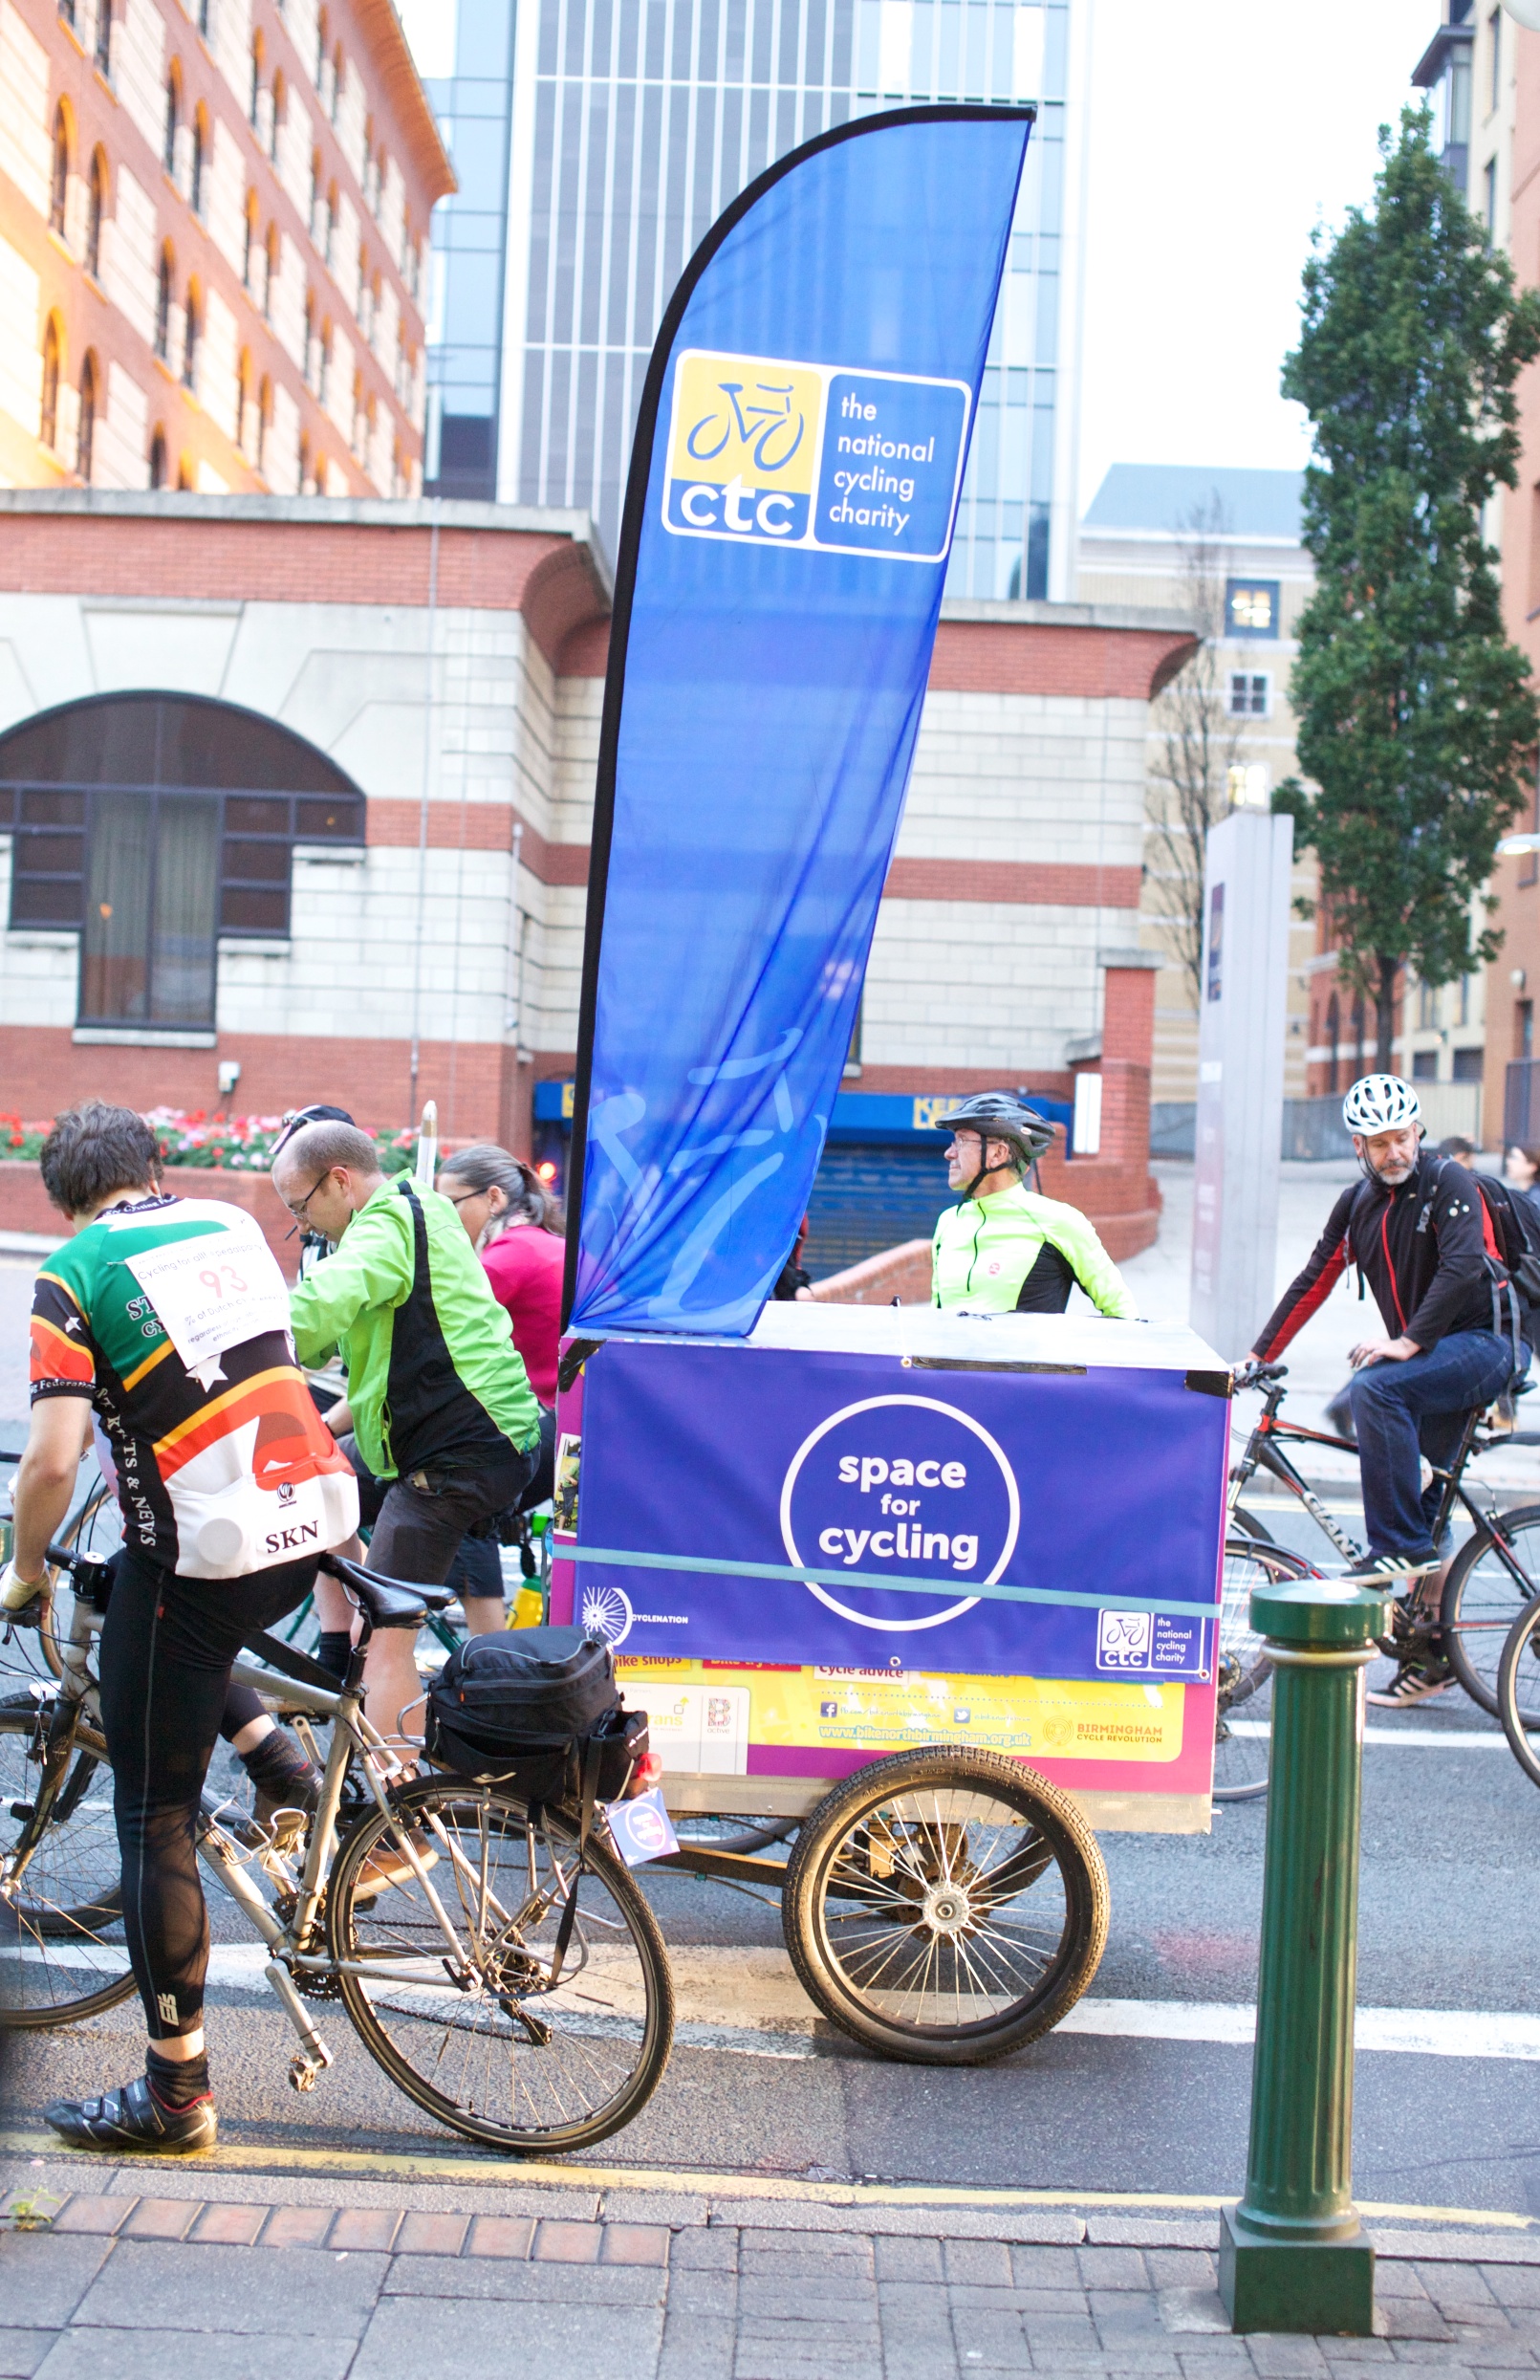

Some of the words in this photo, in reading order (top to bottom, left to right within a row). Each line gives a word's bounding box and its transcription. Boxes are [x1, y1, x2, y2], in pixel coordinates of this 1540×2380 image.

[841, 392, 877, 421] the
[837, 433, 935, 463] national
[834, 466, 915, 502] cycling
[681, 473, 795, 535] ctc
[829, 497, 910, 536] charity
[138, 1260, 178, 1280] Cycling
[178, 1257, 192, 1269] for
[209, 1243, 263, 1258] pedalpay
[199, 1265, 249, 1299] 93
[197, 1309, 207, 1320] of
[209, 1299, 234, 1316] Dutch
[187, 1323, 223, 1344] regardless
[95, 1387, 116, 1408] ST
[107, 1413, 138, 1469] KTS
[126, 1475, 141, 1490] &
[837, 1455, 967, 1493] space
[880, 1493, 921, 1517] for
[265, 1519, 318, 1554] SKN
[1303, 1490, 1364, 1566] GIANT
[818, 1522, 979, 1571] cycling
[631, 1613, 688, 1625] CYCLENATION
[1158, 1617, 1171, 1627] the
[1157, 1629, 1192, 1640] national
[1157, 1641, 1186, 1652] cycling
[1104, 1647, 1143, 1667] ctc
[1156, 1652, 1185, 1665] charity
[819, 1725, 1031, 1747] www.bikenorthbirmingham.org.uk
[1076, 1734, 1105, 1742] CYCLE
[1107, 1735, 1162, 1743] REVOLUTION
[1077, 1723, 1162, 1736] BIRMINGHAM
